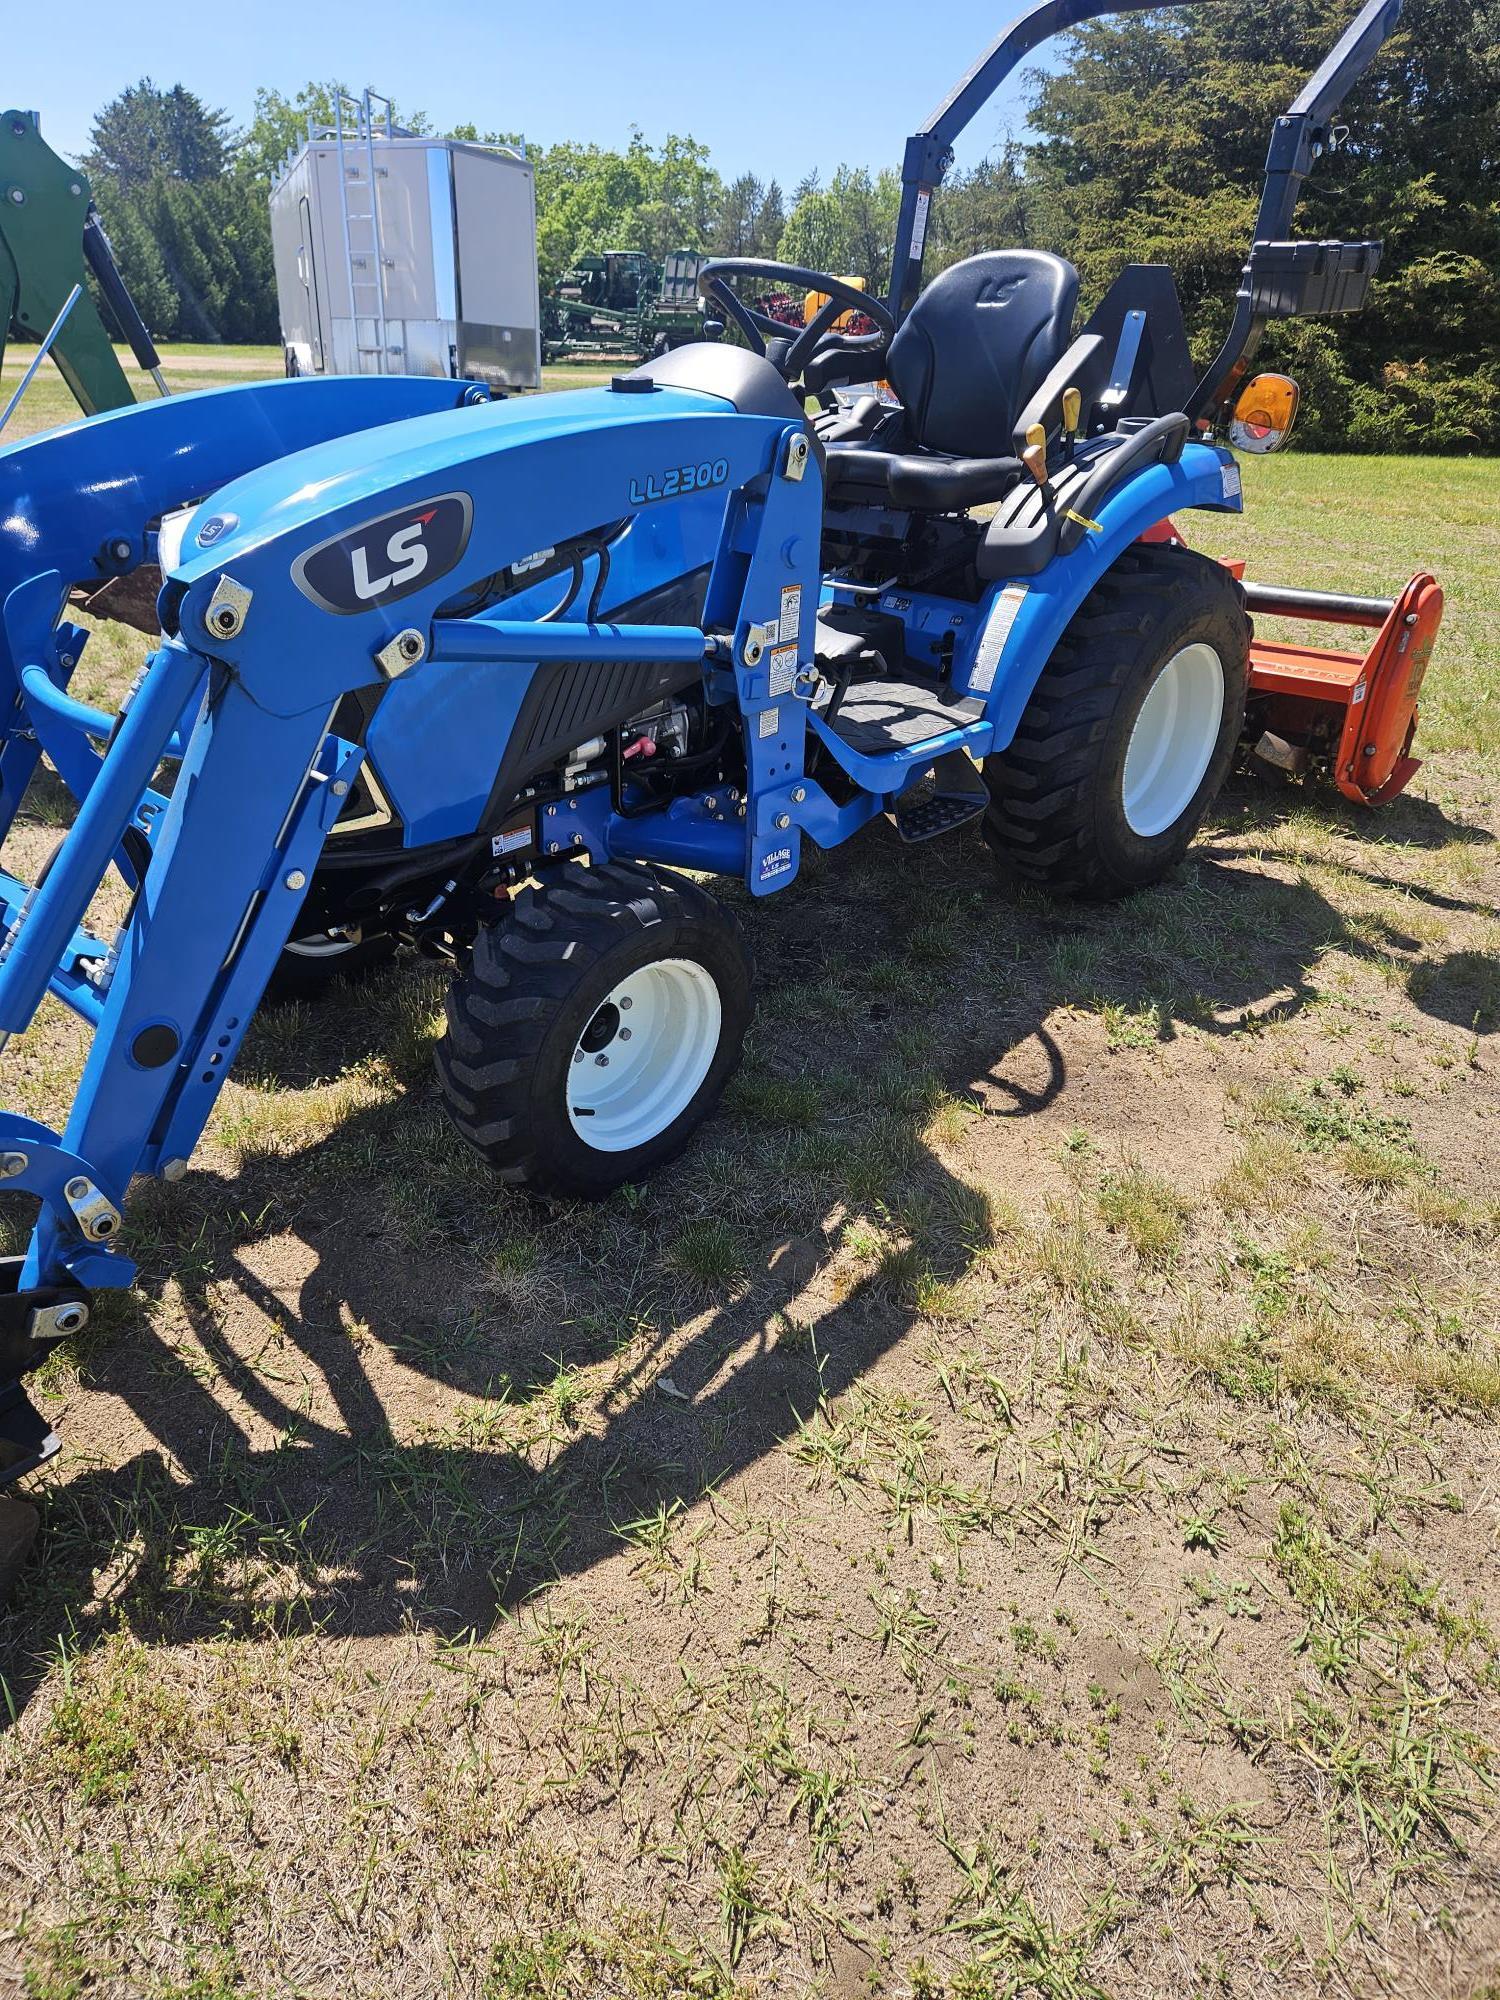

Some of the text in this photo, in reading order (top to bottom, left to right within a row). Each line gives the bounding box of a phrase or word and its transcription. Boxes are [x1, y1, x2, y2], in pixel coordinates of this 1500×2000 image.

[629, 458, 729, 505] LL2300
[351, 522, 428, 600] LS
[762, 849, 791, 867] VILLAGE
